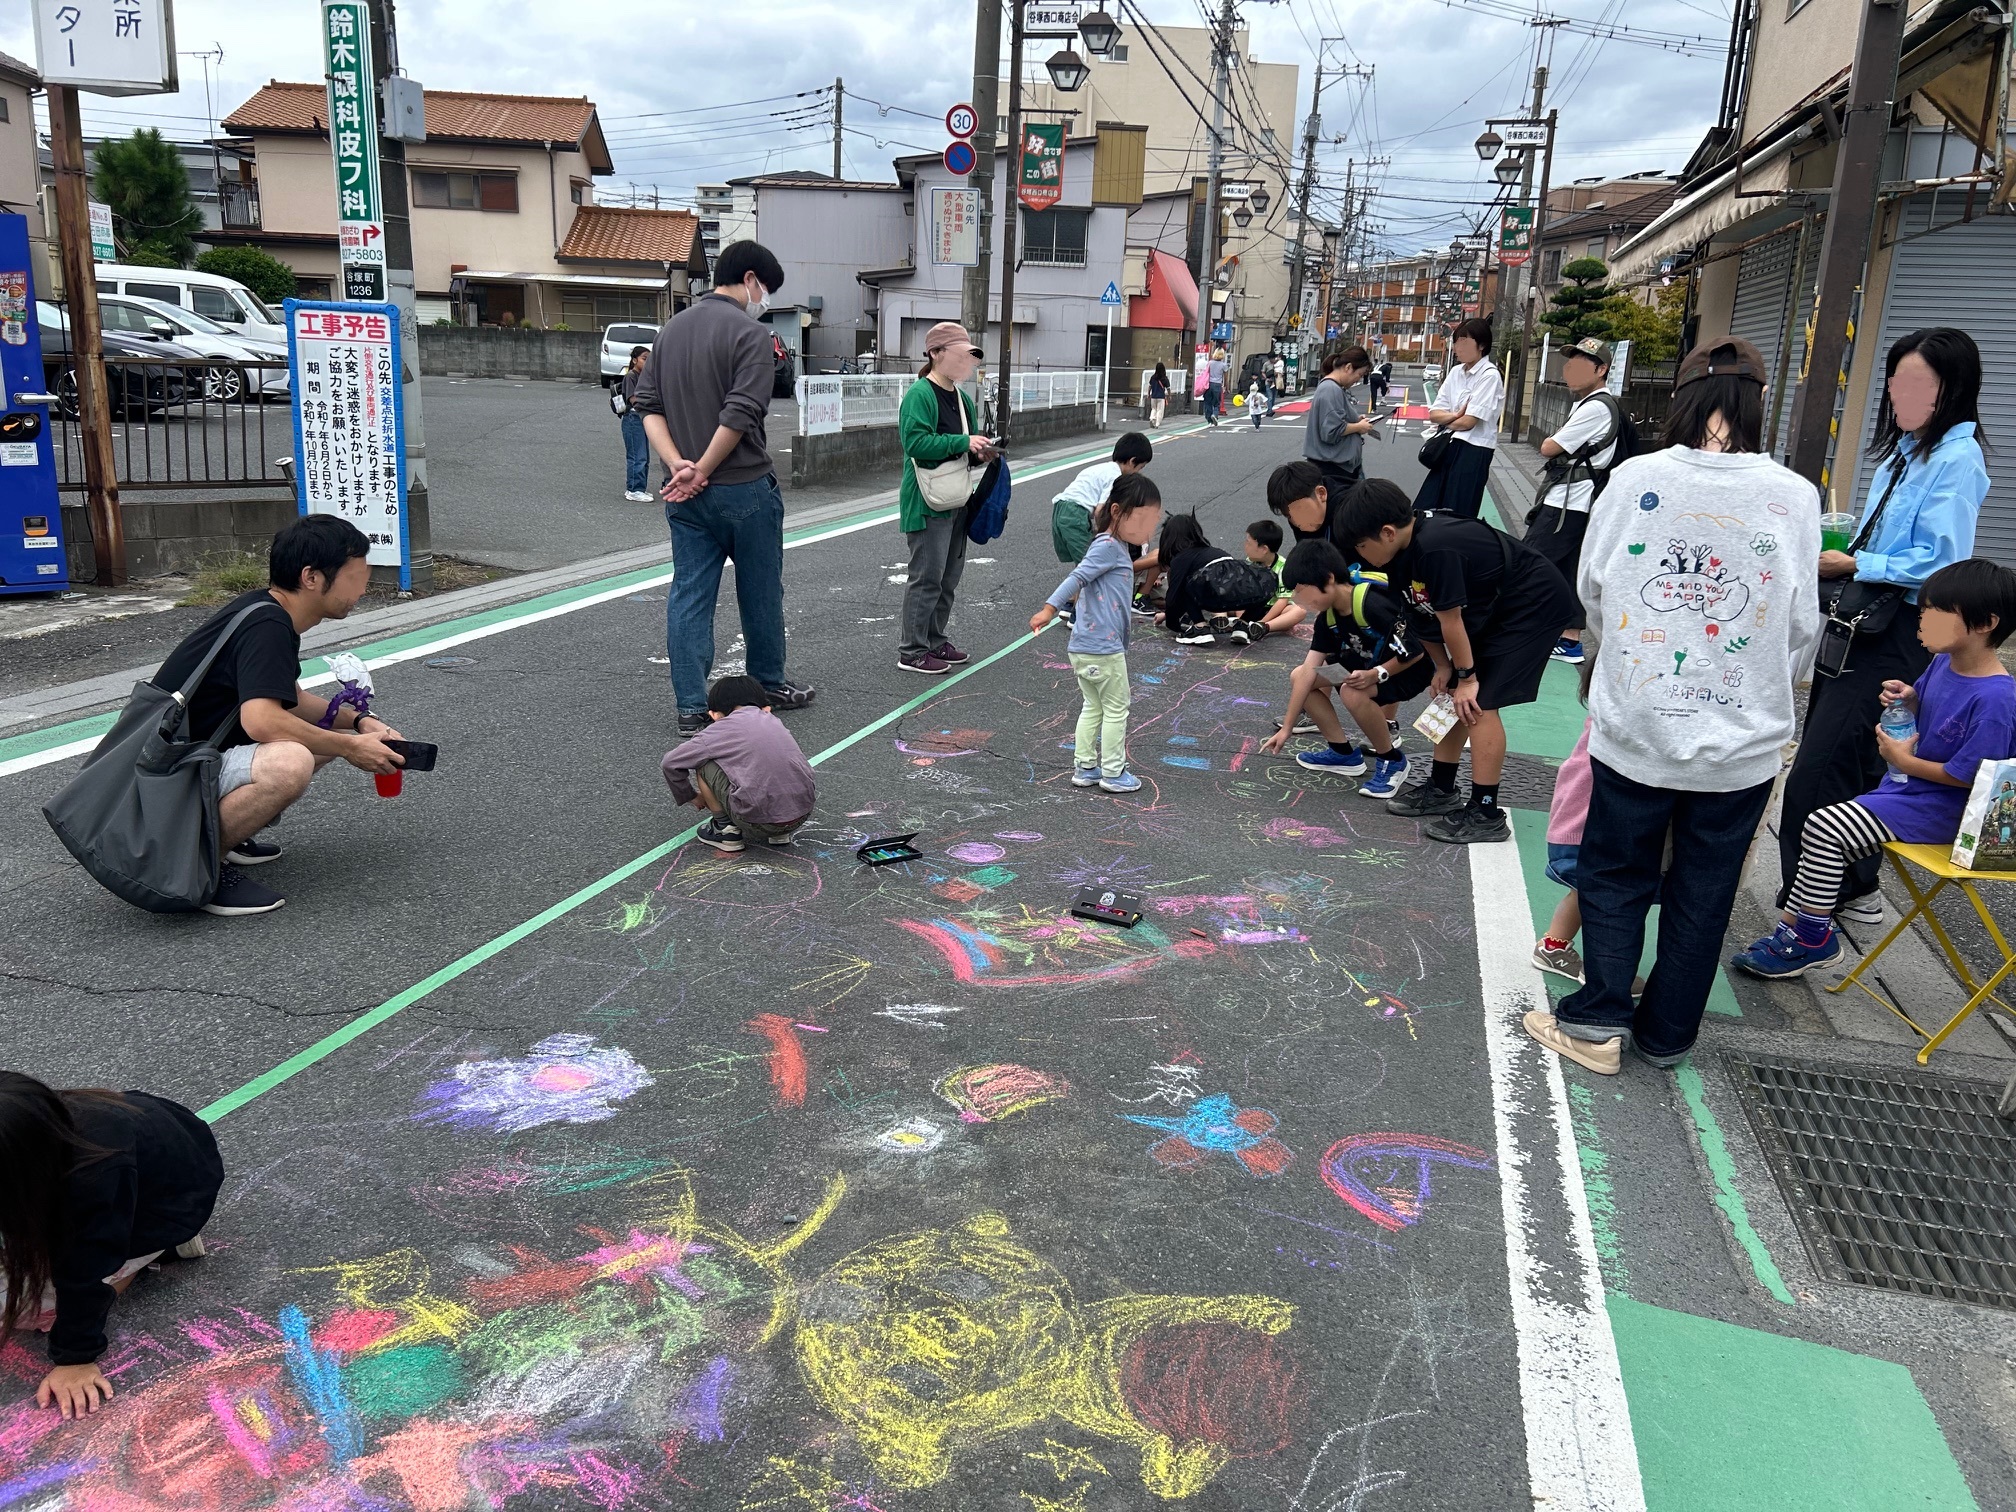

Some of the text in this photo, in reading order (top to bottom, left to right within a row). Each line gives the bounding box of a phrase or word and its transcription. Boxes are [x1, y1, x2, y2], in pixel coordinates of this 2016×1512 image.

[56, 6, 81, 67] ター
[113, 0, 142, 39] 所
[330, 9, 367, 217] 鈴木眼科皮フ科
[953, 114, 971, 129] 30
[943, 192, 952, 262] 通りぬけできません
[954, 192, 964, 233] 大型車両
[965, 192, 975, 225] この先
[346, 271, 374, 283] 谷塚町
[350, 285, 373, 296] 1236
[299, 313, 386, 339] 工事予告
[307, 361, 321, 394] 期間
[303, 399, 320, 499] 令和7年10月27日まで
[316, 400, 333, 500] 令和7年6月2日から
[328, 347, 350, 516] ご協力をお願いいたします。
[344, 347, 367, 516] 大変ご迷惑をおかけしますが
[1656, 580, 1724, 594] ME AND YOU
[1663, 591, 1722, 607] HAPPY
